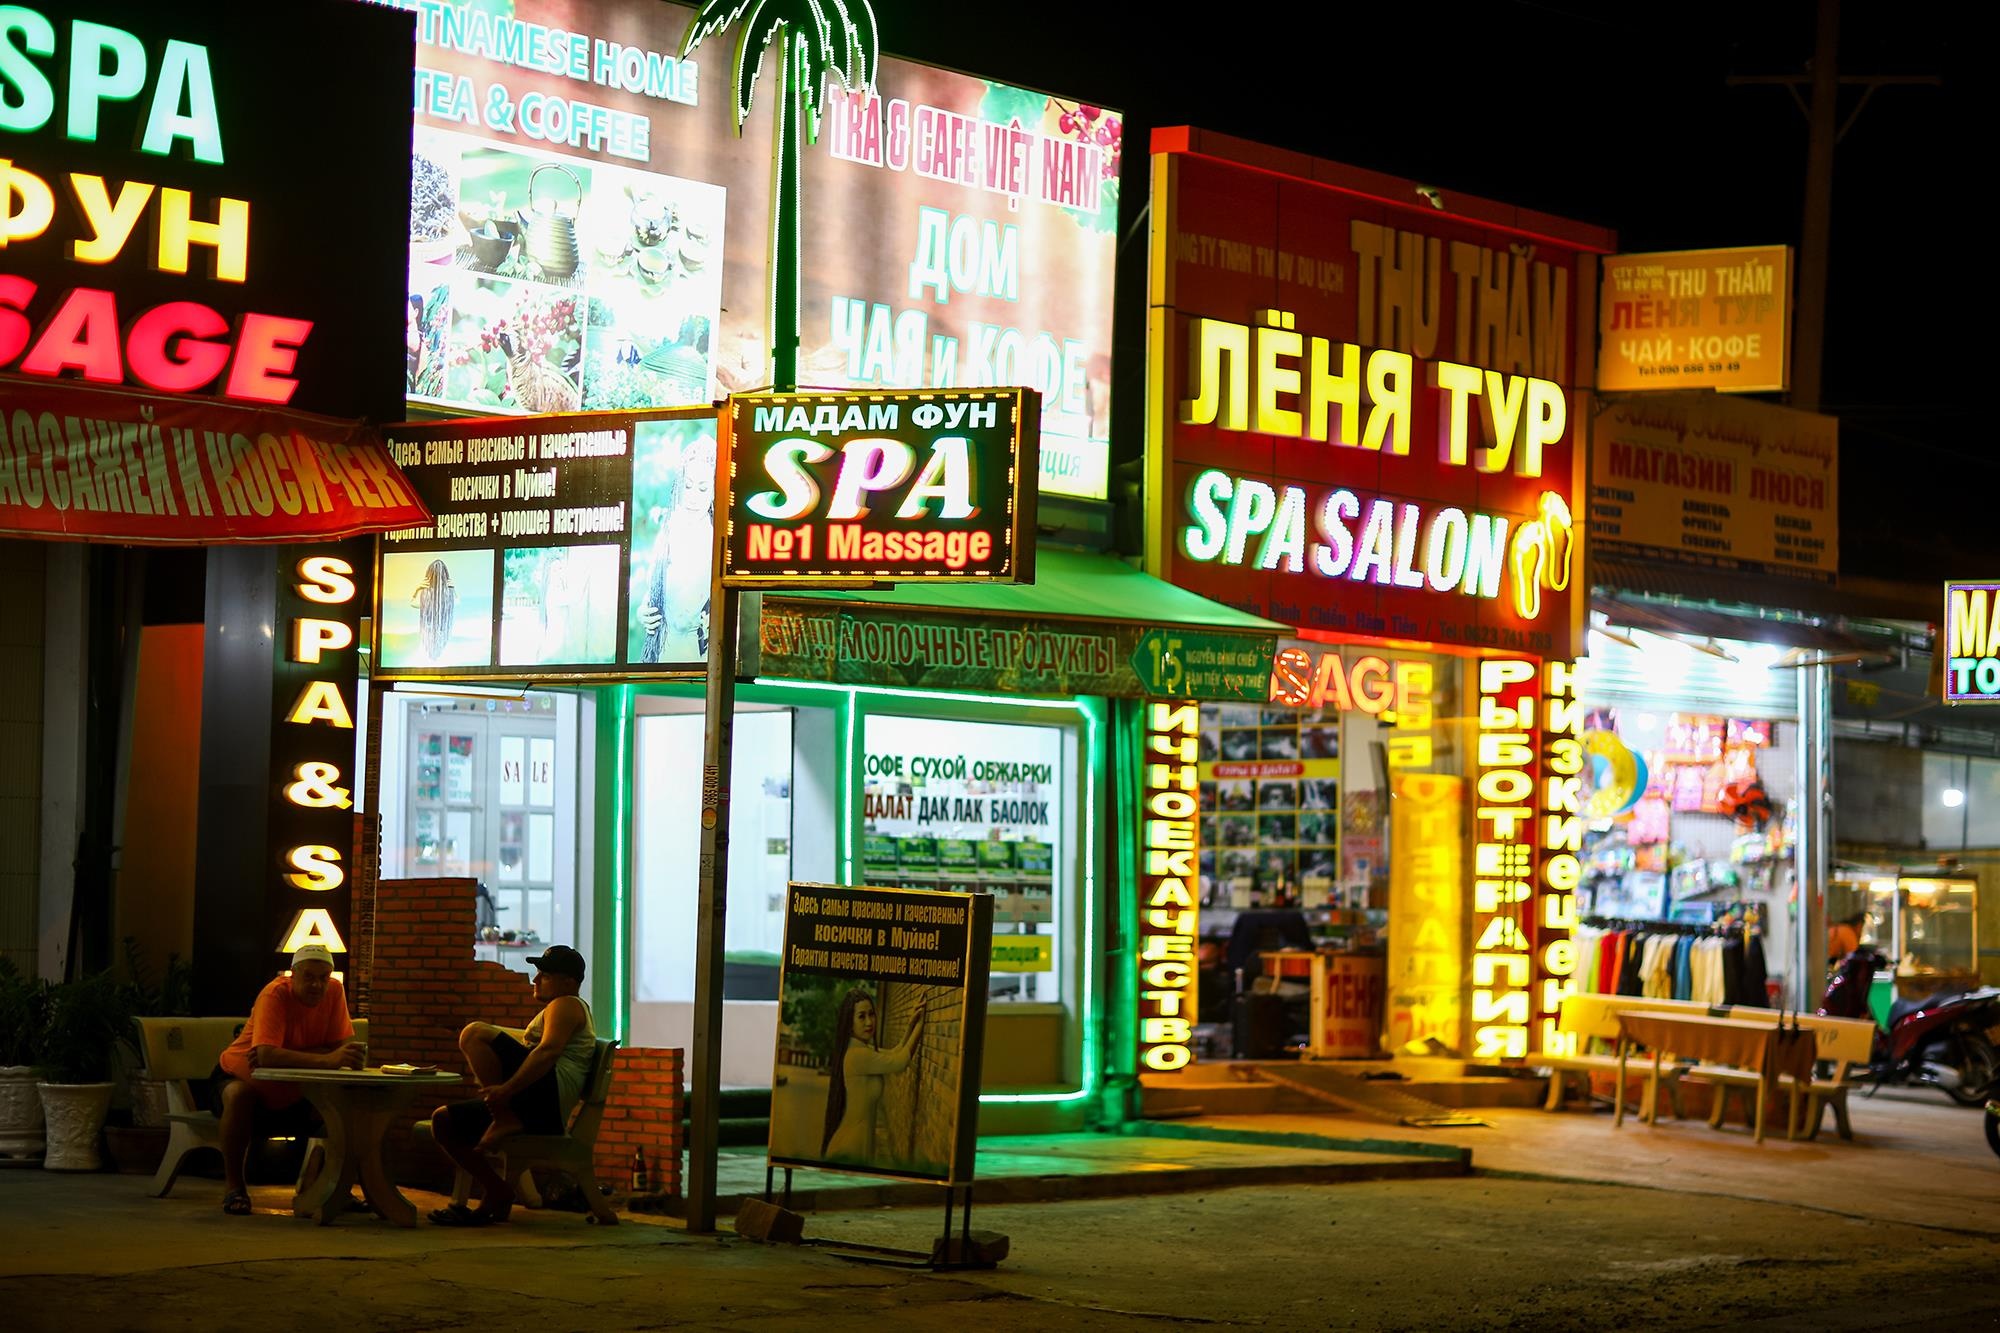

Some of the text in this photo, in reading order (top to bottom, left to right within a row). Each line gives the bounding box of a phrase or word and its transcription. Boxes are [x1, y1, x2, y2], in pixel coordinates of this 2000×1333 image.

[400, 0, 698, 106] TNAMESE HOME
[0, 5, 224, 165] SPA
[415, 66, 650, 162] TEA & COFFEE
[886, 98, 911, 172] &
[912, 104, 977, 188] CAFE
[980, 116, 1036, 212] VIỆT
[1041, 136, 1103, 215] NAM
[909, 205, 1018, 304] ДОМ
[1351, 220, 1441, 360] THU
[1667, 269, 1707, 298] THU
[1610, 294, 1775, 330] ЛЁНЯ ТУР
[831, 296, 927, 388] ЧАЯ
[966, 321, 1090, 416] КОФЕ
[1620, 332, 1673, 363] ЧАЙ
[1688, 334, 1761, 361] КОФЕ
[753, 401, 998, 436] МАДАМ ФУН
[1189, 309, 1567, 478] ЛЁНЯ ТУР
[171, 426, 214, 517] И
[203, 429, 412, 517] КОСИЧЕК
[425, 437, 463, 465] самые
[467, 434, 525, 465] красивые
[529, 437, 538, 459] и
[540, 429, 627, 458] качественные
[450, 466, 557, 501] косички в Муйне!
[745, 437, 982, 520] SPA
[1609, 441, 1733, 496] МАГАЗИН
[1749, 466, 1825, 511] ЛЮСЯ
[437, 512, 487, 538] качества
[501, 510, 550, 538] хорошее
[553, 501, 625, 535] настроение!
[826, 523, 993, 569] Massage
[1184, 469, 1509, 599] SPA SALON
[839, 616, 989, 669] МОЛОЧНЫЕ
[991, 629, 1116, 679] ПРОДУКТЫ
[1271, 648, 1432, 715] SAGE
[287, 761, 353, 810] &
[911, 755, 966, 781] СУХОЙ
[972, 761, 1053, 786] ОБЖАРКИ
[864, 793, 1050, 827] ДАЛАТ ДАК ЛАК БАОЛОК
[793, 892, 965, 926] Здесь самые красивые и качественные
[791, 944, 960, 979] Гарантия качества хорошее настроение!
[814, 924, 940, 951] косички в Муйне!
